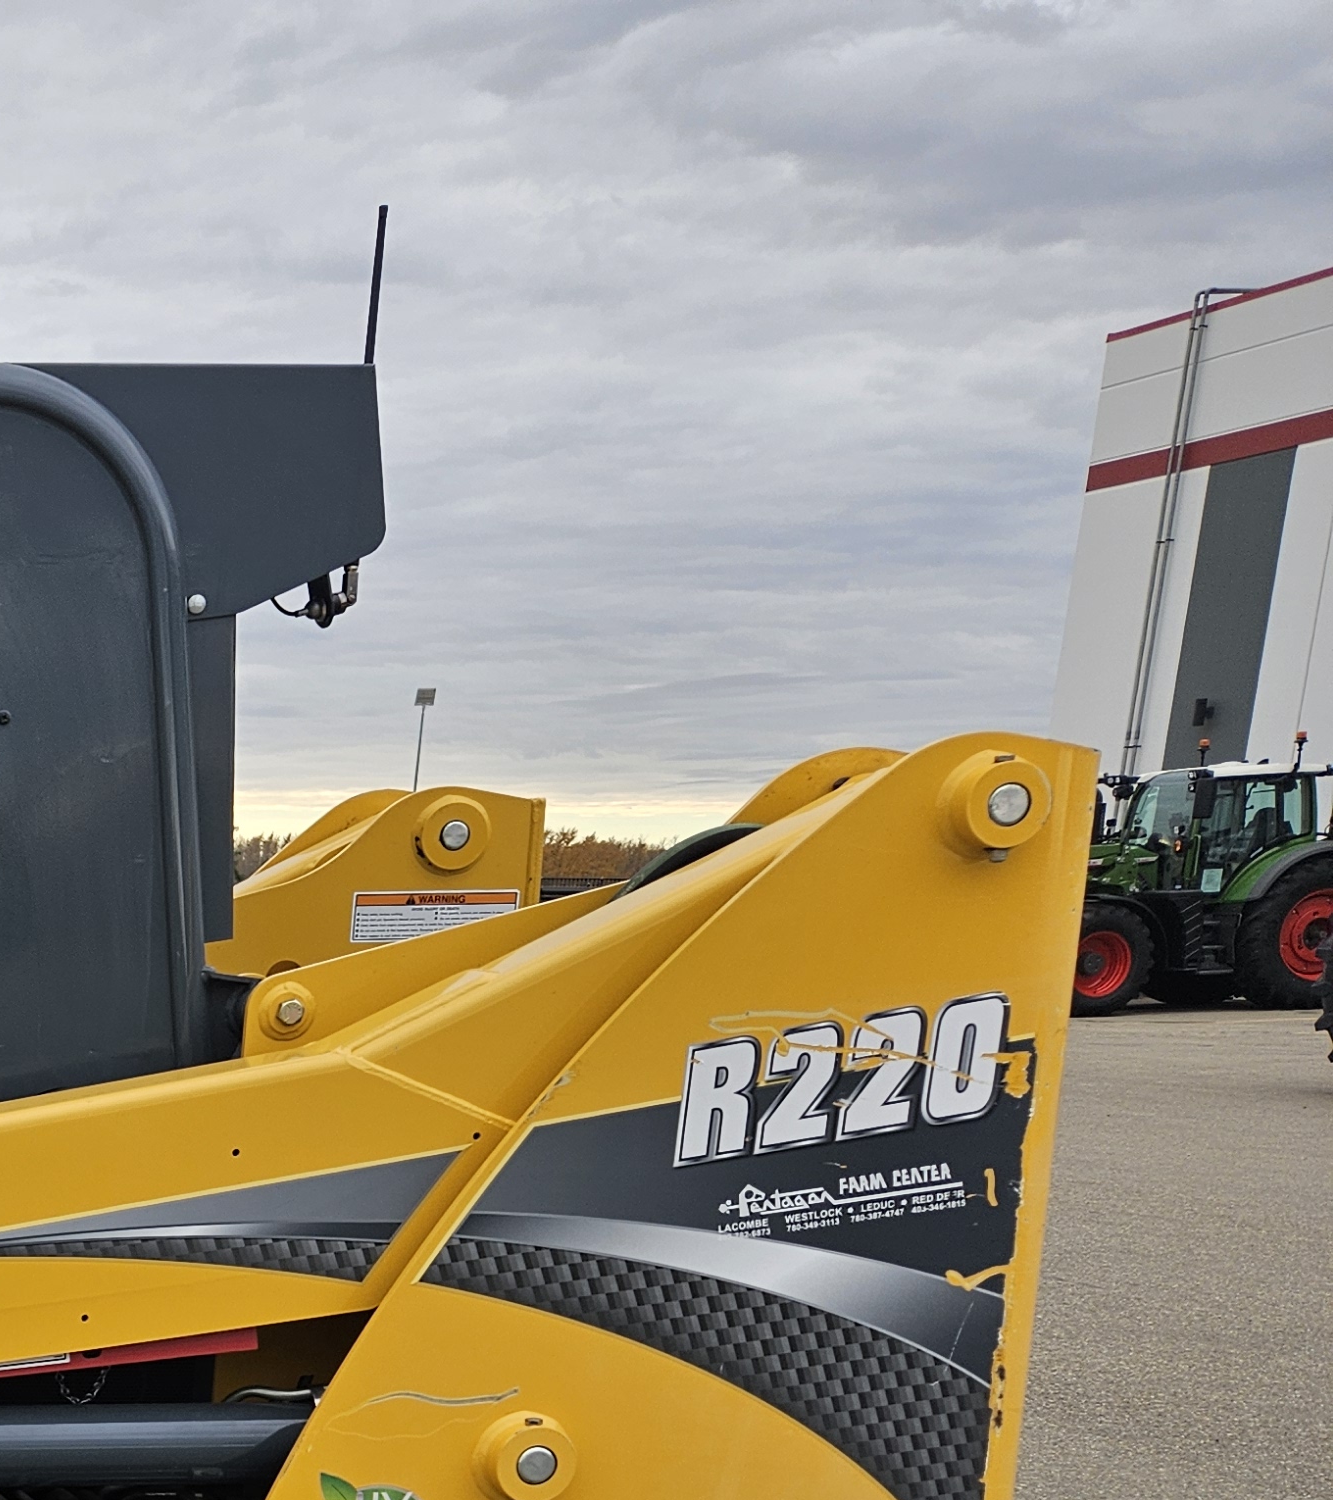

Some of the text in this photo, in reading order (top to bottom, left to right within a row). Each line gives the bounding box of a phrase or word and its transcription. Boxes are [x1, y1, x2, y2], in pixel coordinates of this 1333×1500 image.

[418, 895, 466, 904] WARNING
[673, 991, 1013, 1168] R220
[839, 1172, 888, 1195] FARM
[893, 1162, 952, 1187] CENTER
[717, 1218, 769, 1234] LACOMBE
[784, 1206, 843, 1224] WESTLOCK
[860, 1199, 896, 1213] LEDUC
[911, 1194, 934, 1205] RED
